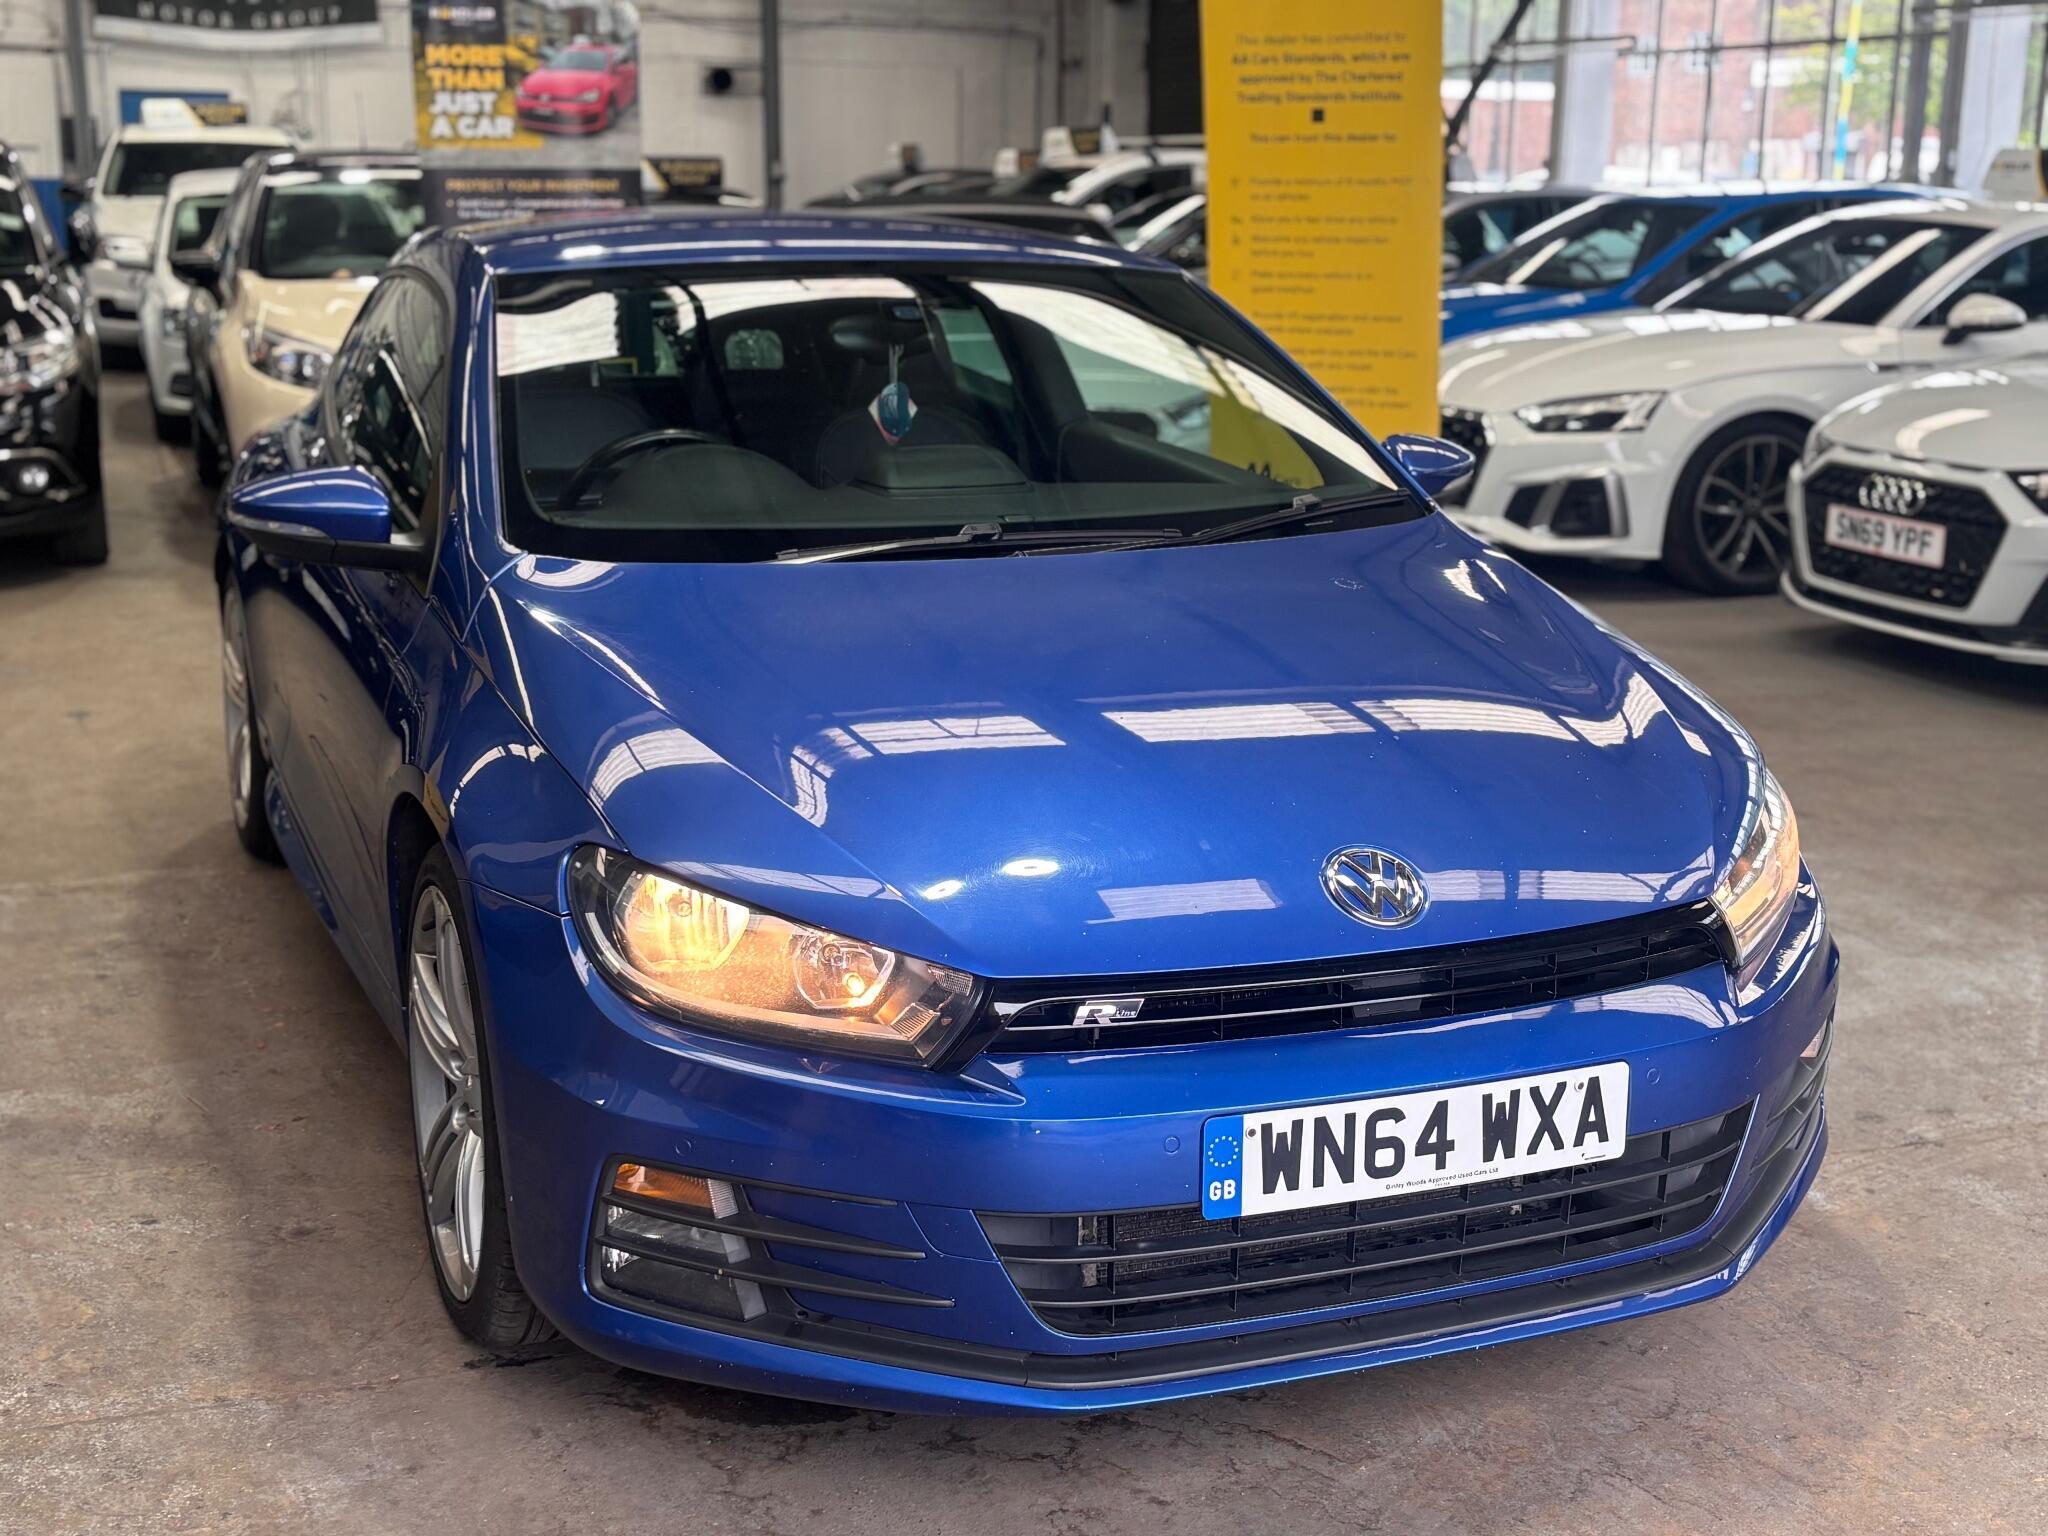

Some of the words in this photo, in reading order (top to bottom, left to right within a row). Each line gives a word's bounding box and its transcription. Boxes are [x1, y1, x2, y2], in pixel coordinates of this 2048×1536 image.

[137, 2, 233, 29] MOTOR
[251, 5, 341, 30] GROUP
[425, 43, 505, 67] MORE
[426, 67, 506, 91] THAN
[1343, 69, 1404, 83] Chartered
[429, 91, 498, 114] JUST
[430, 115, 455, 139] A
[457, 115, 515, 139] CAR
[1836, 511, 1886, 549] SN69
[1891, 522, 1933, 556] YPF
[1261, 1099, 1455, 1195] WN64
[1482, 1076, 1609, 1163] WXA
[1209, 1179, 1236, 1201] GB
